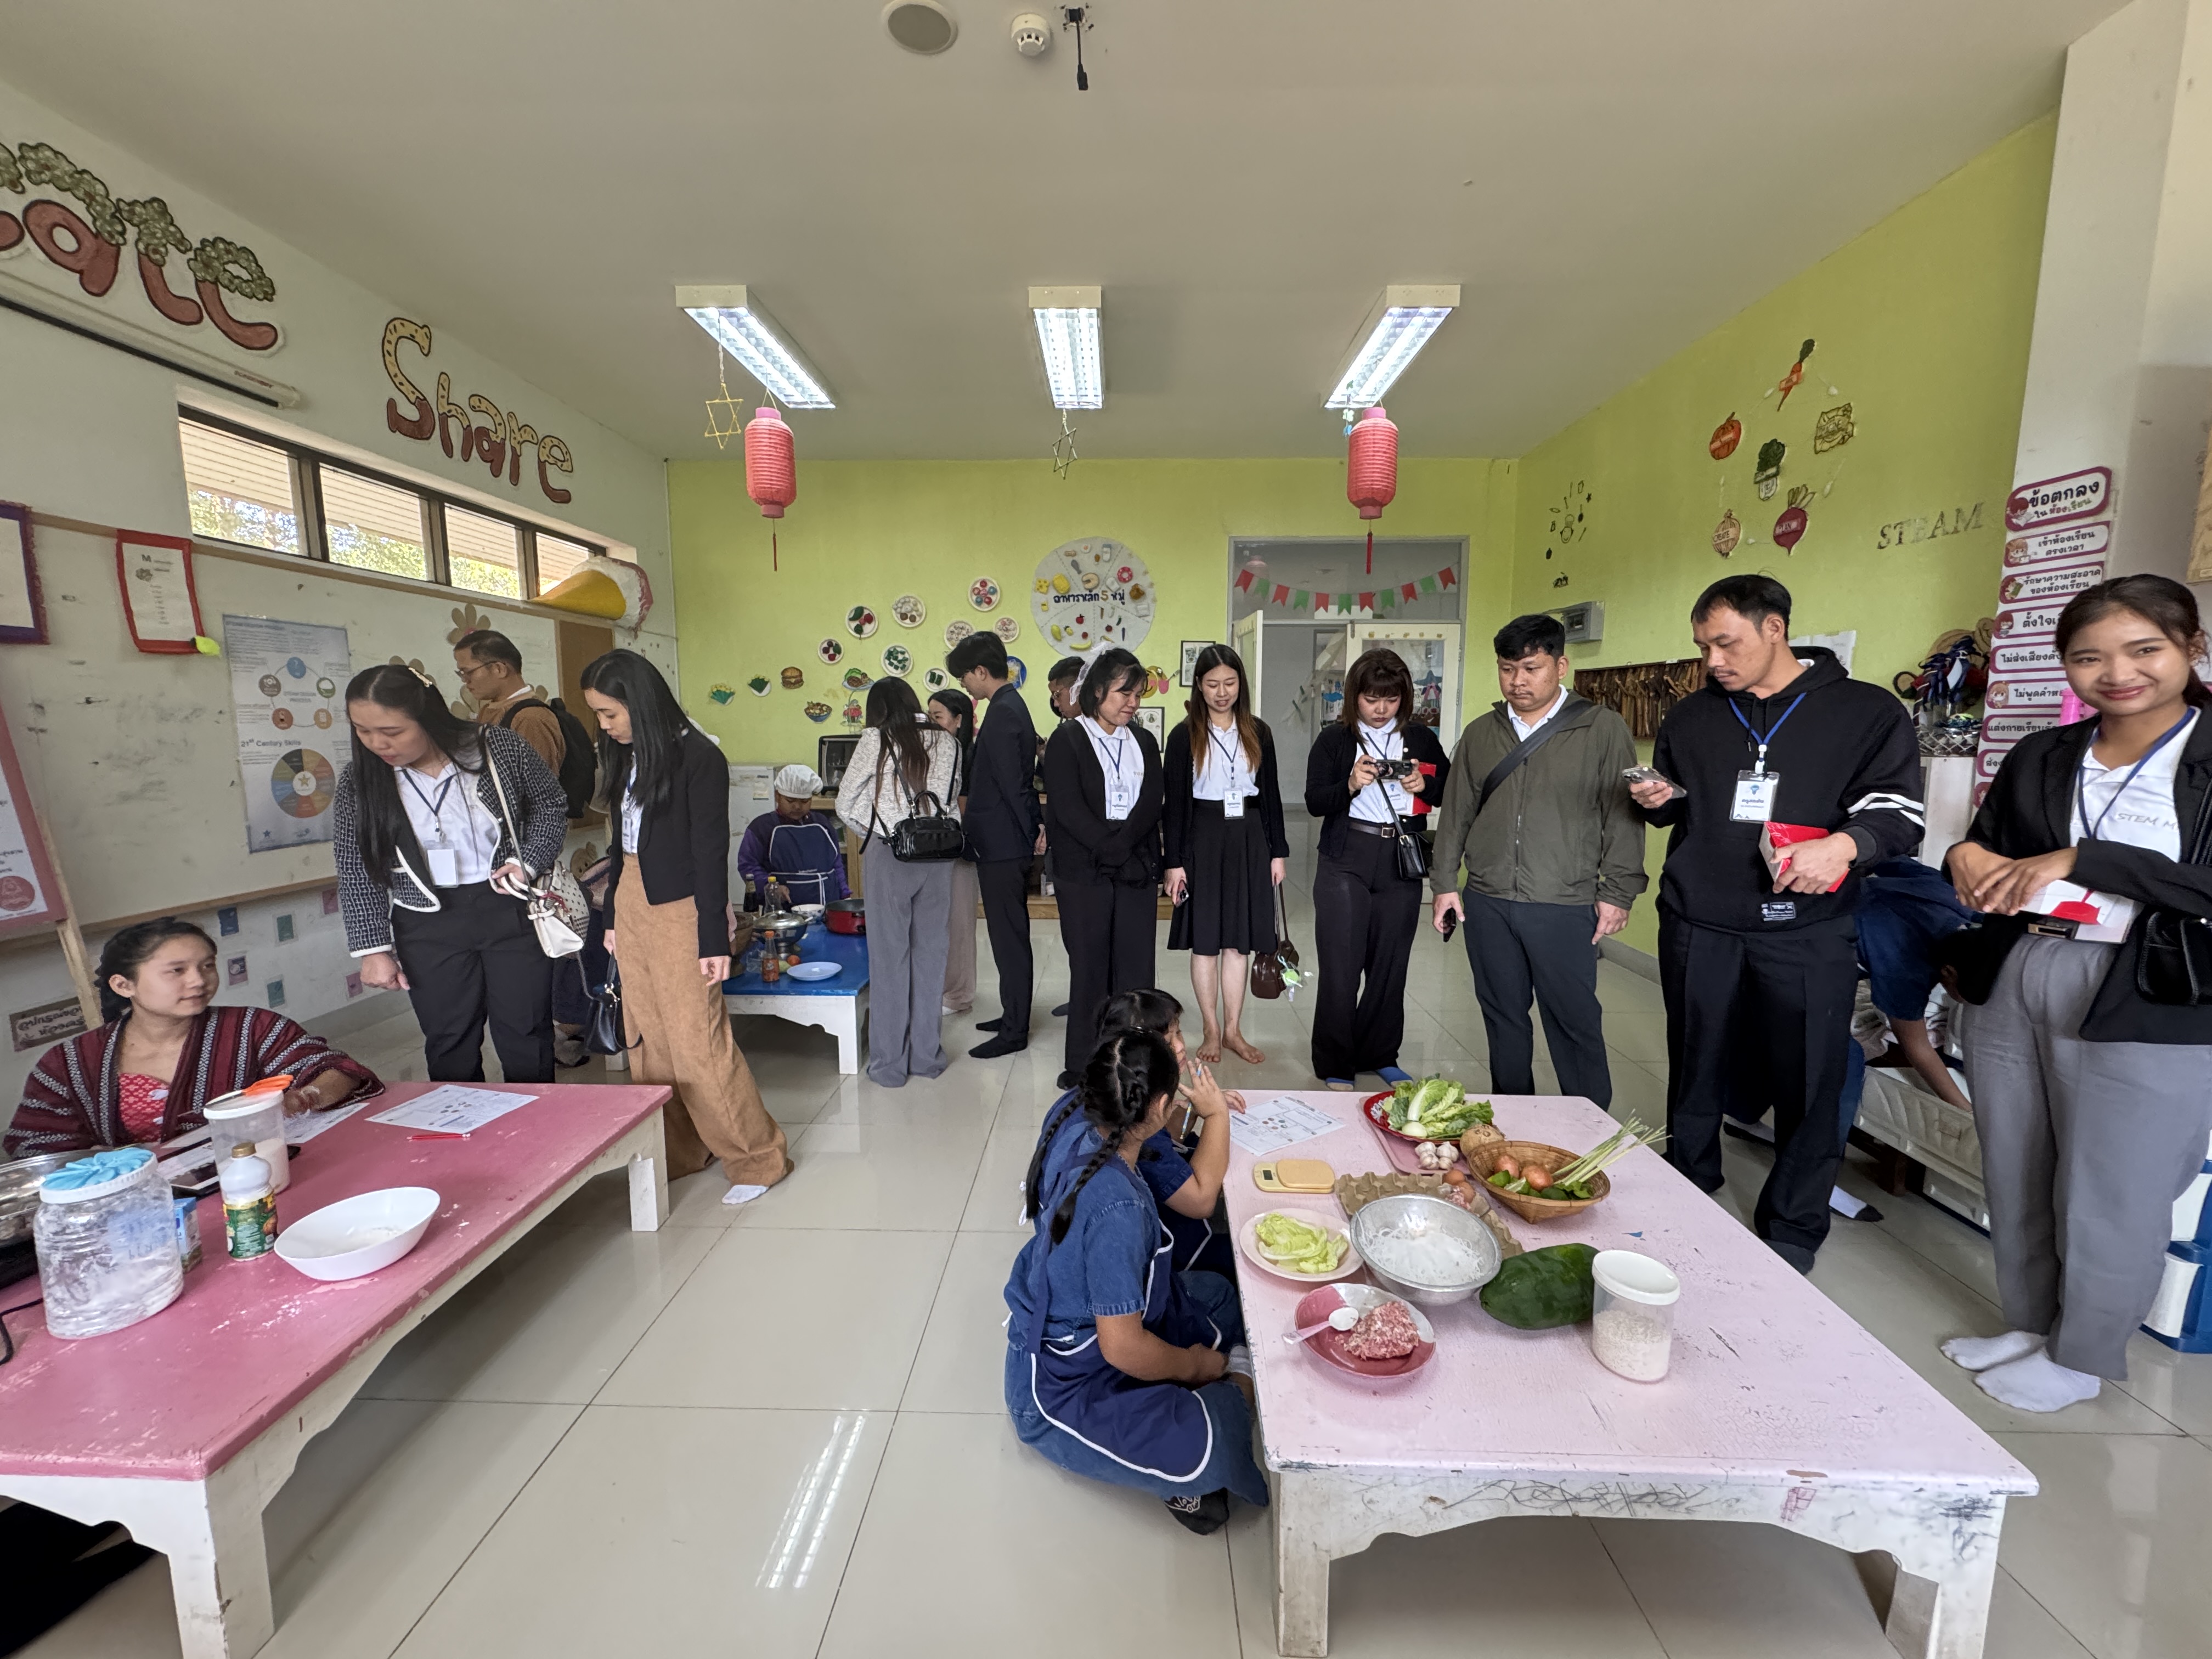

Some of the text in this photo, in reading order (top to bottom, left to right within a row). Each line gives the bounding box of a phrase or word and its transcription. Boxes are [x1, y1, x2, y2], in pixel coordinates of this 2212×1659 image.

[382, 317, 573, 504] Share
[2029, 481, 2100, 507] ข้อตกลง
[1876, 501, 1985, 549] STEAM
[1713, 530, 1730, 543] CREATE
[2038, 530, 2095, 548] เข้าห้องเรียน
[2045, 544, 2084, 556] ตรงเวลา
[2024, 568, 2101, 585] รักษาความสะอาด
[2030, 580, 2090, 595] ของห้องเรียน
[1053, 589, 1126, 606] อาหารหลัก 5 หมู่
[2023, 611, 2061, 628] ตั้งใจเ
[2117, 813, 2159, 826] STEM
